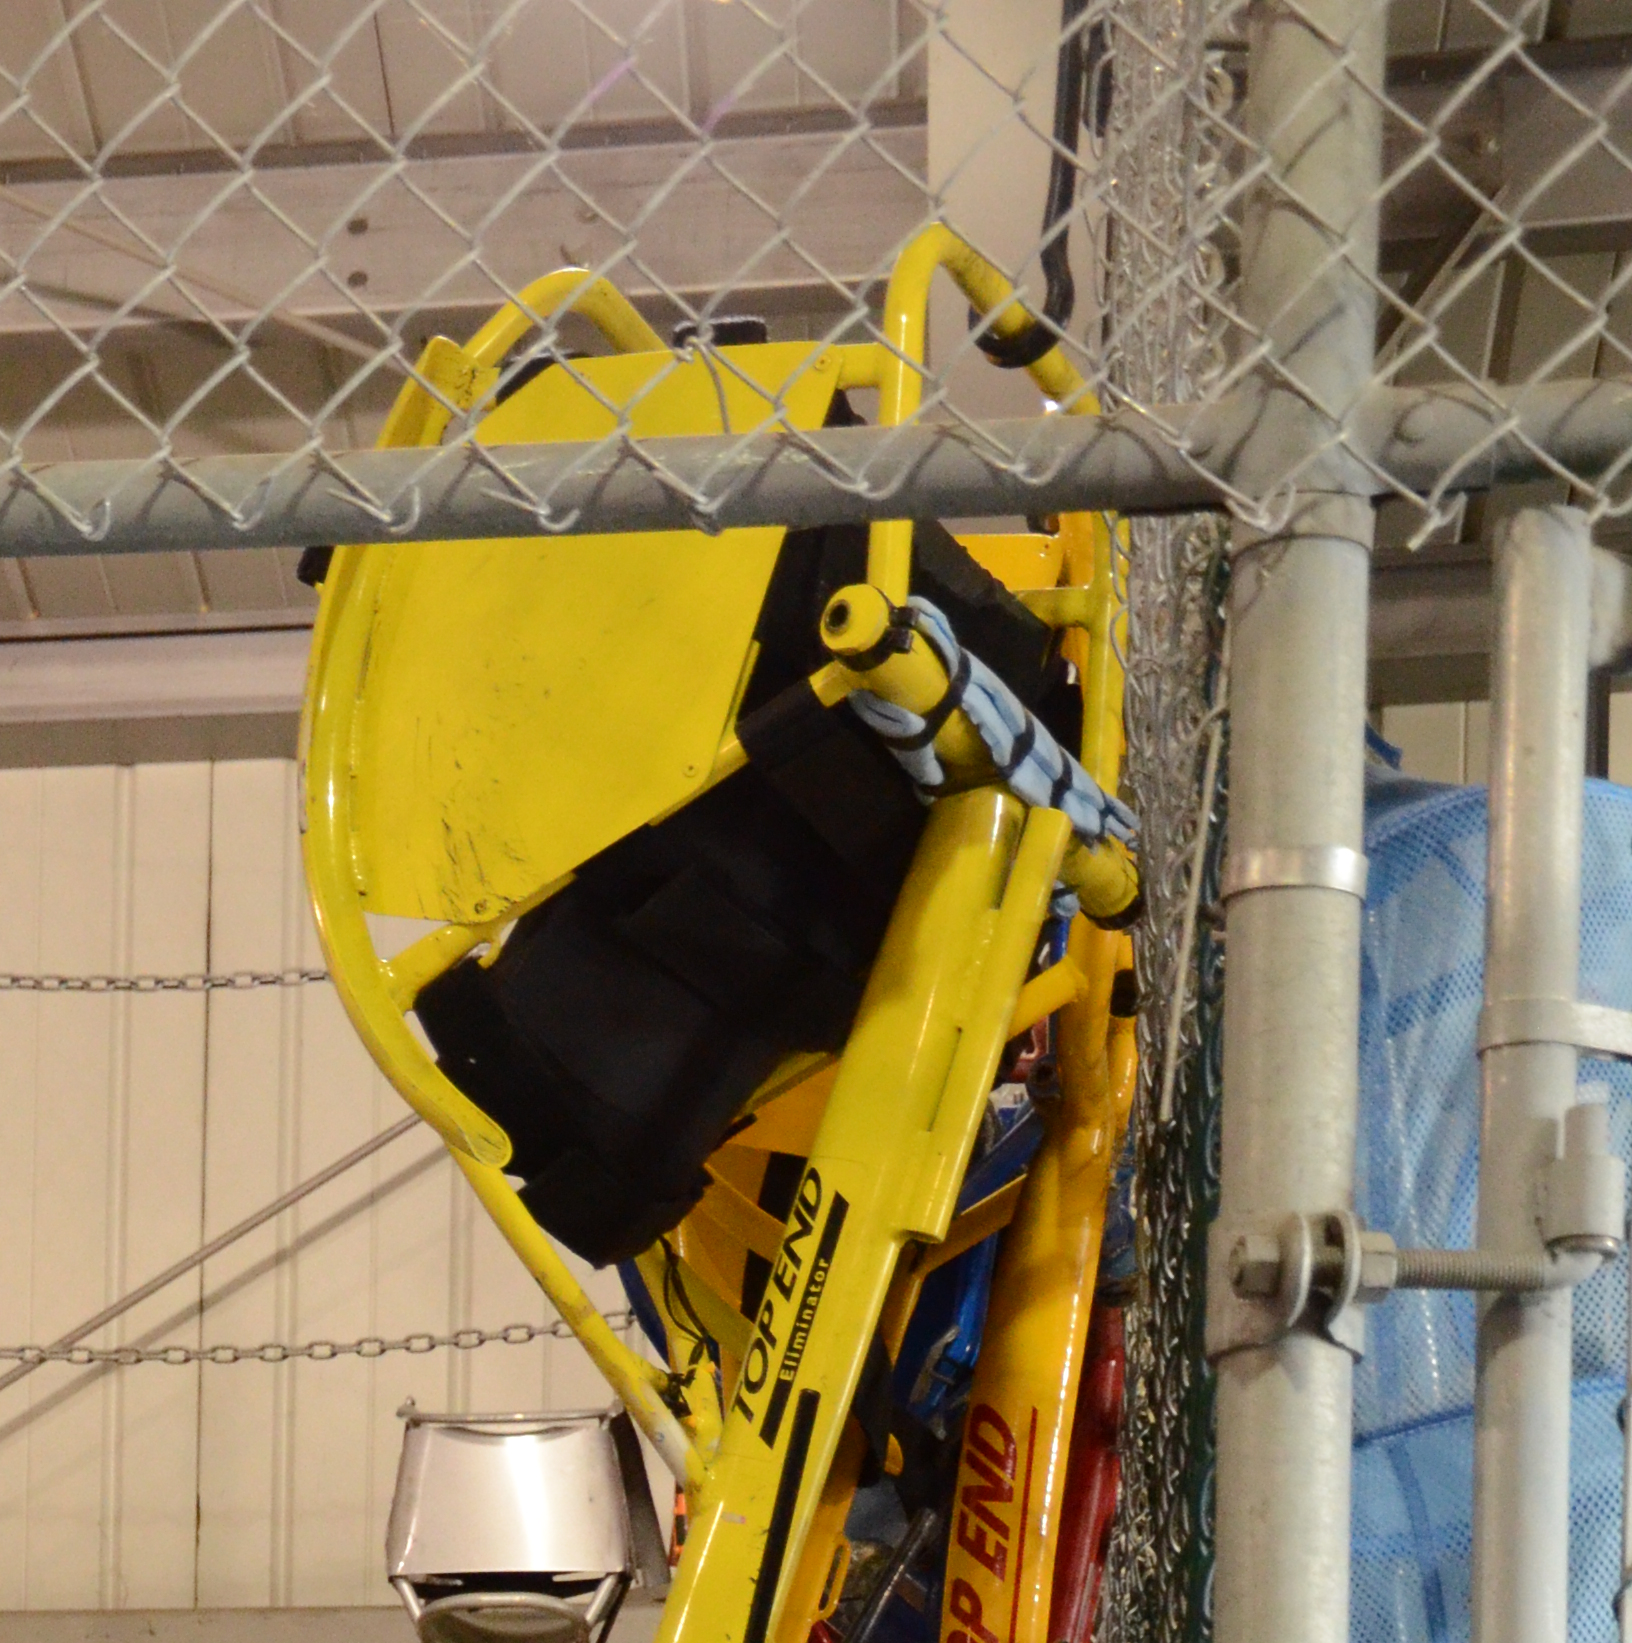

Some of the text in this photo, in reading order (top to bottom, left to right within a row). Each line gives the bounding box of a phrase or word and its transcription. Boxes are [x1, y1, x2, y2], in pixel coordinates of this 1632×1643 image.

[732, 1167, 822, 1424] TOP END
[779, 1257, 830, 1382] Eliminator
[958, 1403, 1017, 1583] END
